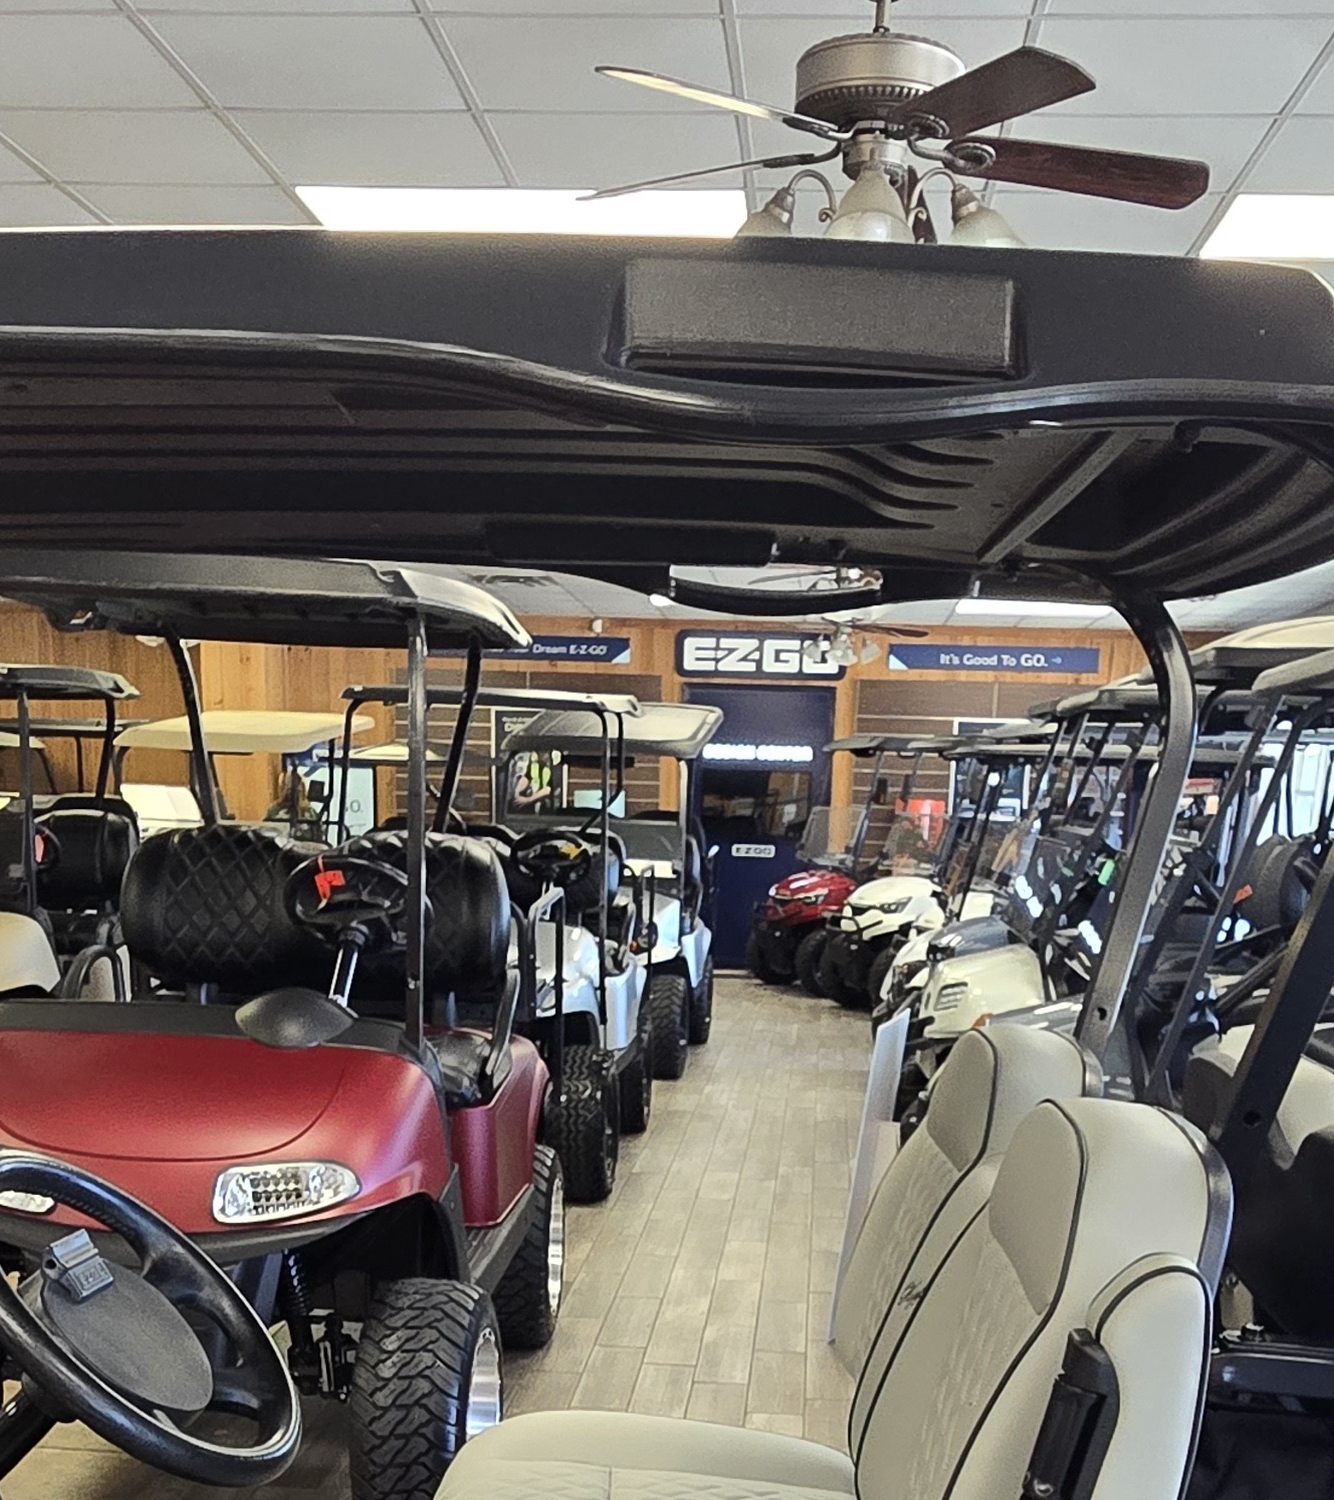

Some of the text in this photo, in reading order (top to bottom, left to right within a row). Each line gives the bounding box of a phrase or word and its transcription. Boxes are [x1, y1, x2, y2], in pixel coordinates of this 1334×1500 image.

[532, 643, 567, 655] Dream
[940, 653, 1048, 667] It's Good To GO.
